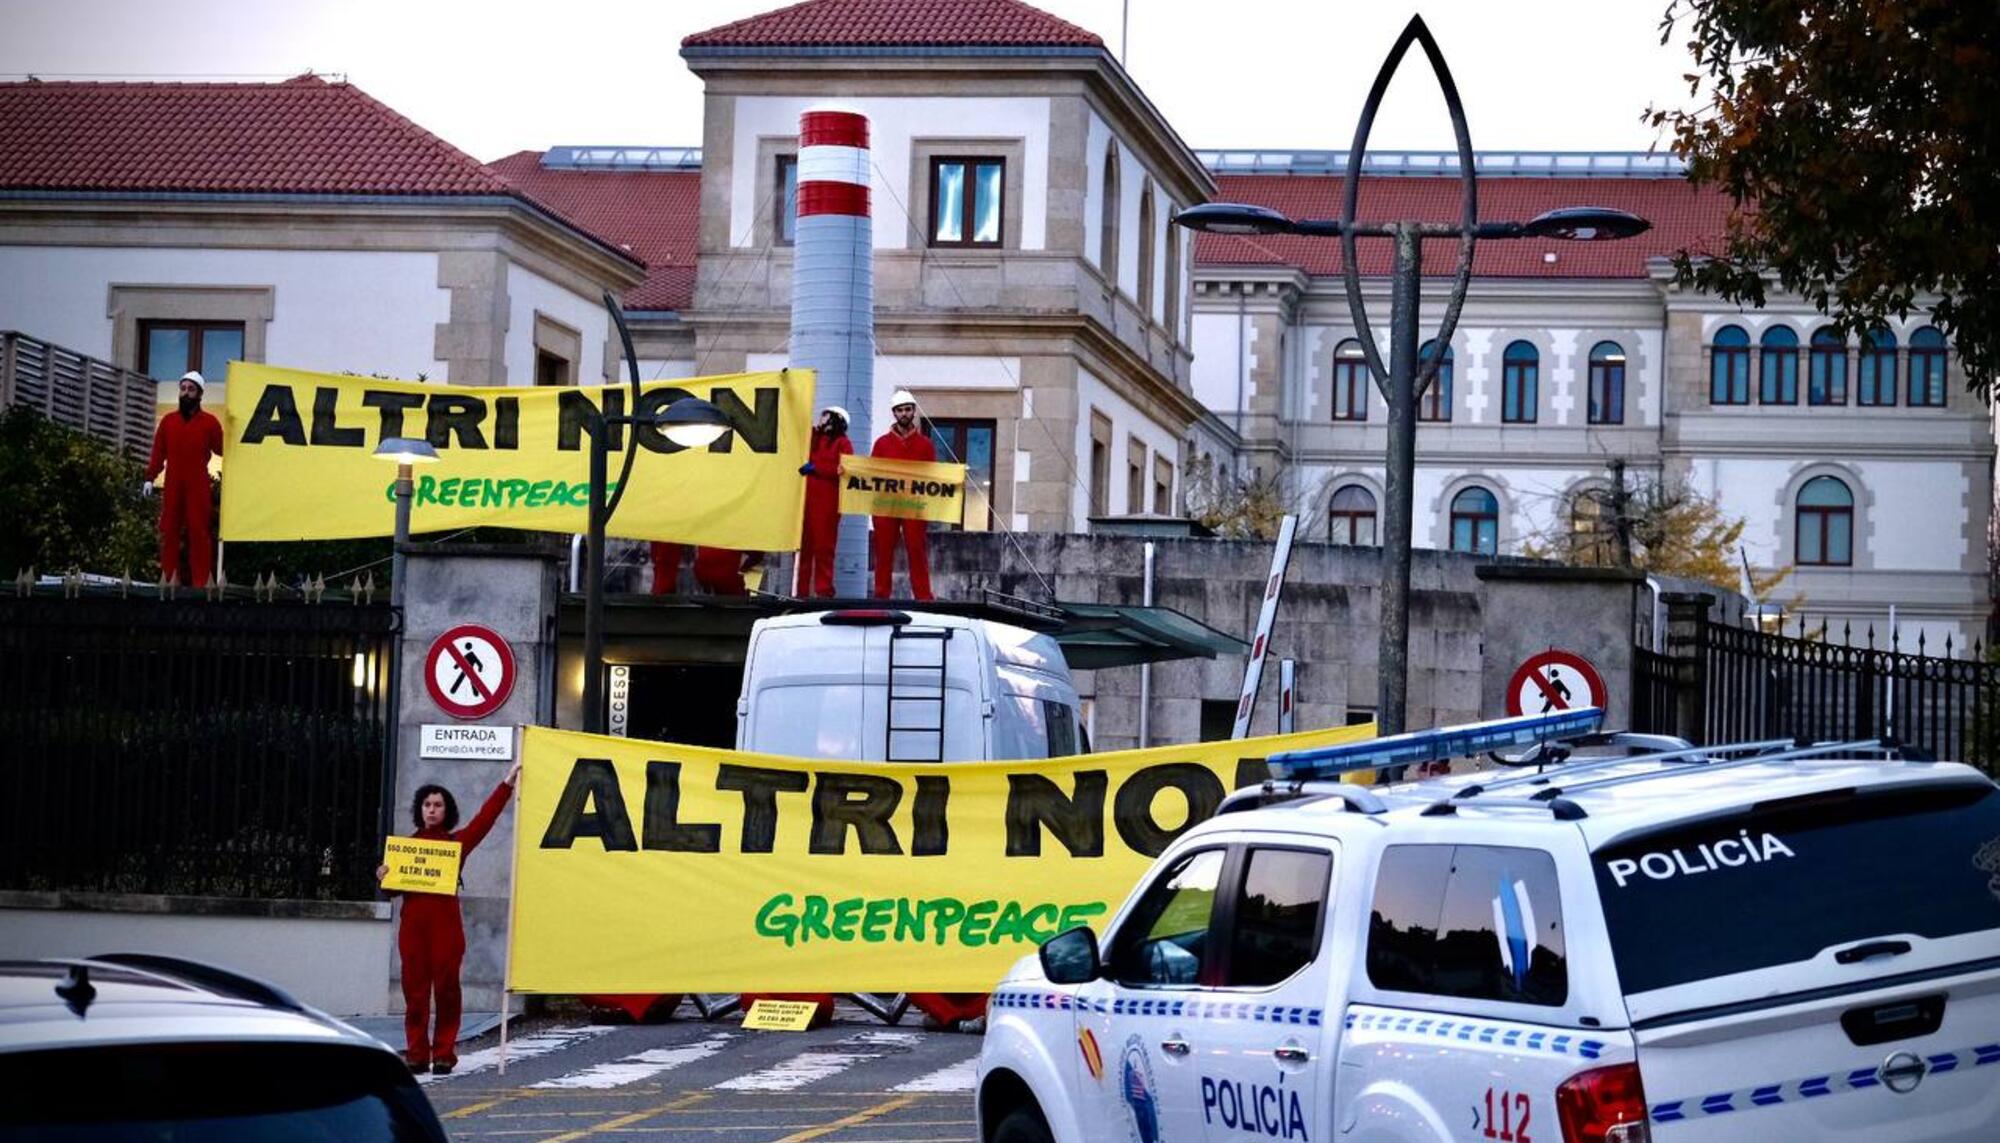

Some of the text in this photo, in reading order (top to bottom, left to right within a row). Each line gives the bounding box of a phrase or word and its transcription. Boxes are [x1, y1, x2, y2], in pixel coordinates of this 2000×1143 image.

[240, 384, 780, 454] ALTRI NON
[847, 476, 955, 497] ALTRI NON
[612, 667, 627, 737] ACCESO
[434, 729, 497, 741] ENTRADA
[540, 757, 1340, 858] ALTRI NO
[400, 865, 441, 877] ALTRI NON
[1201, 1071, 1309, 1143] POLICÍA
[1484, 1088, 1531, 1143] 112
